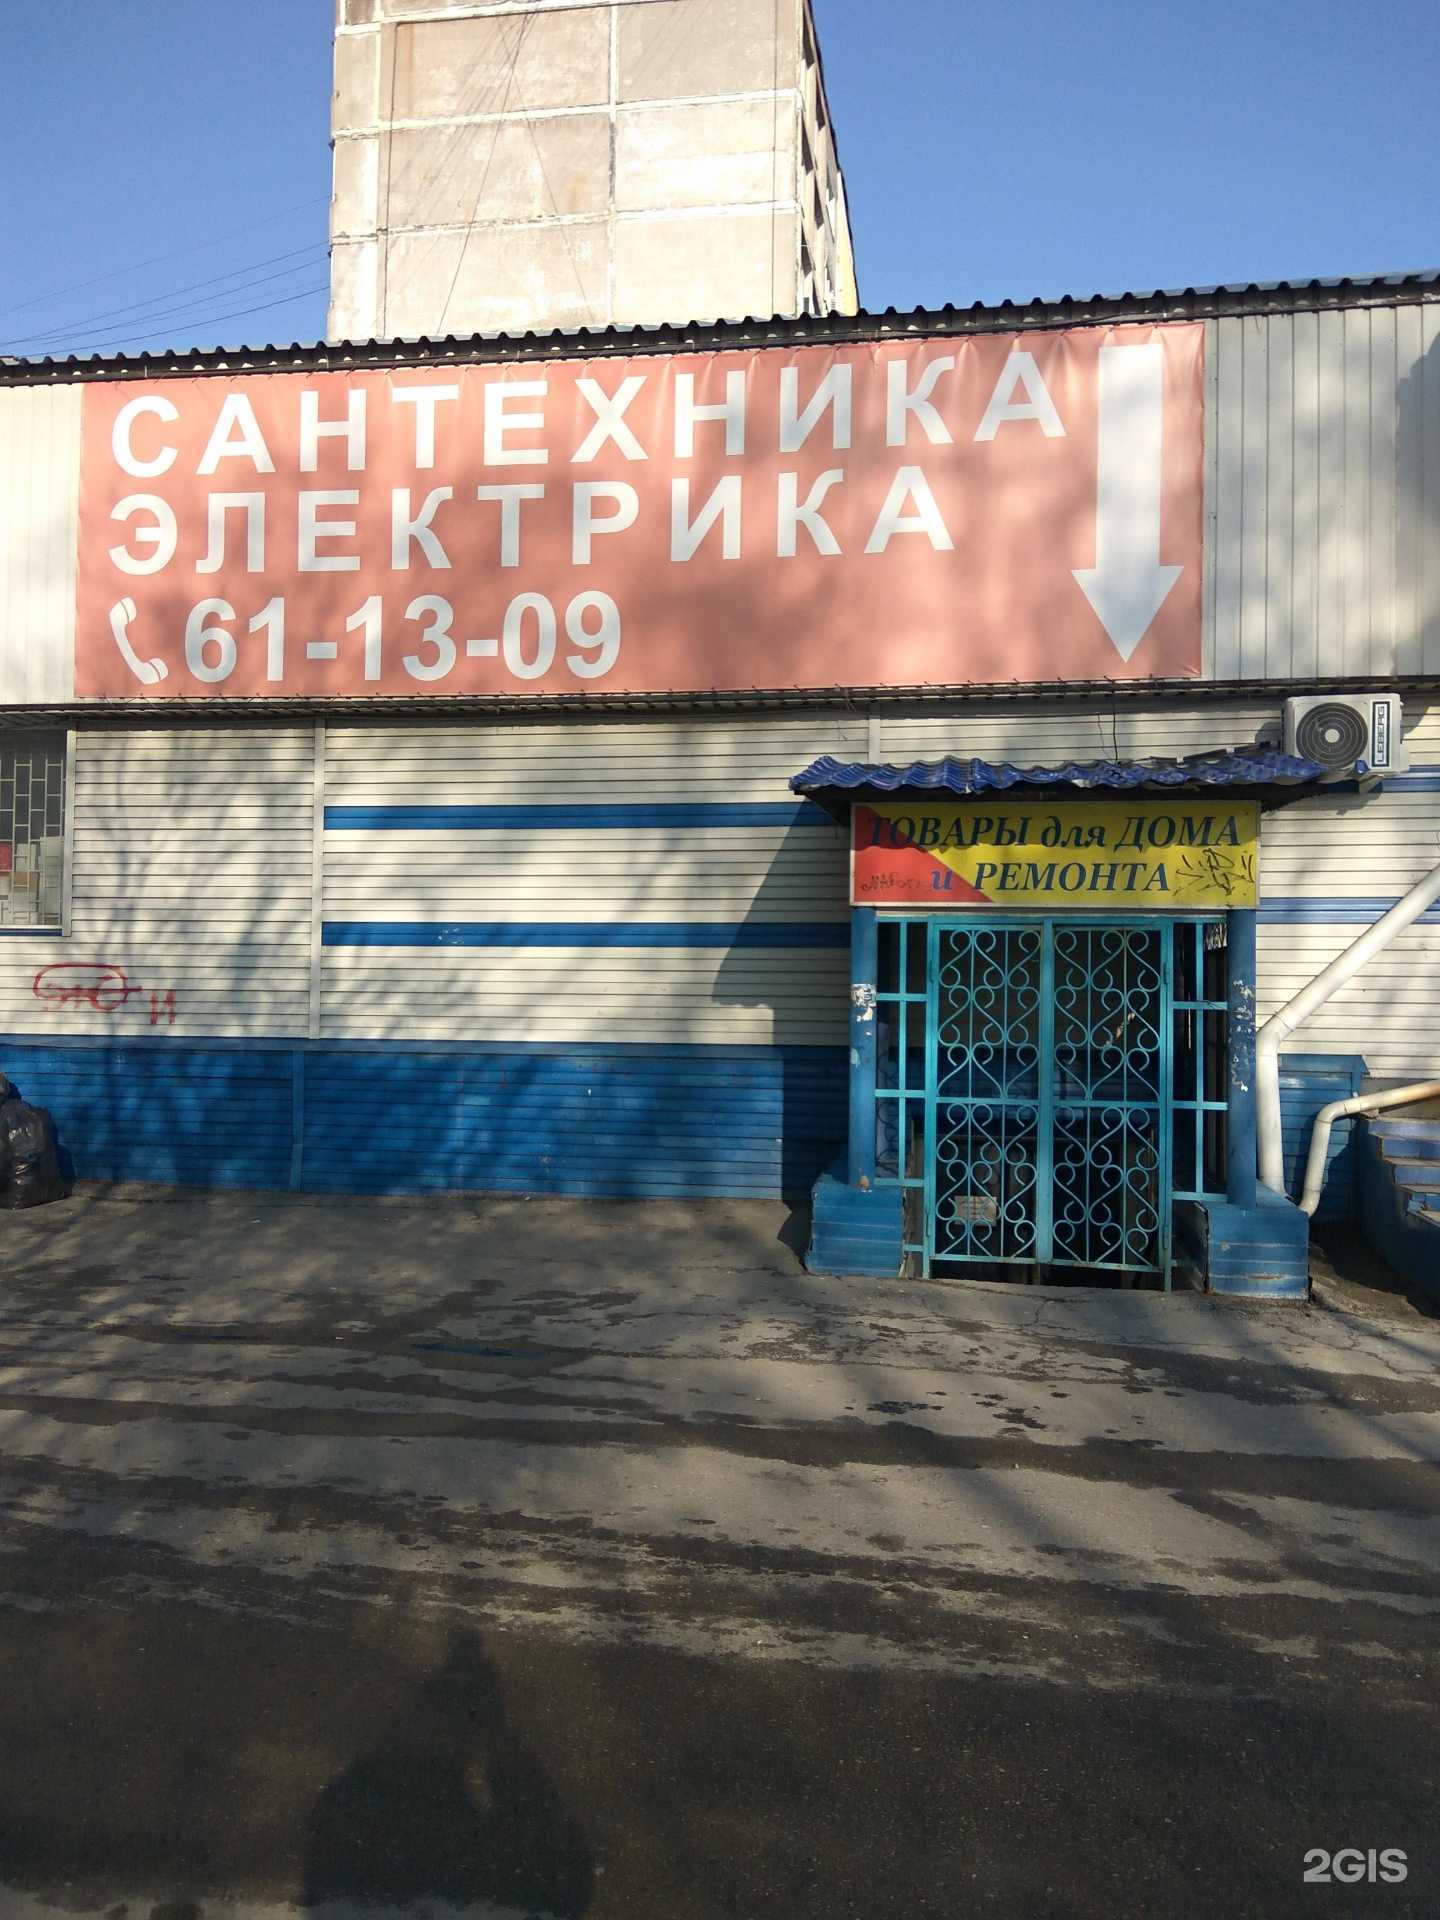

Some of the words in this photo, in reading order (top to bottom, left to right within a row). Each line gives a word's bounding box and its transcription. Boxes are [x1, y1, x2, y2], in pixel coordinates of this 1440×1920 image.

[111, 351, 1067, 478] САНТЕХНИКА
[108, 465, 955, 576] ЭЛЕКТРИКА
[184, 590, 622, 683] 61-13-09
[867, 815, 1031, 849] ТОВАРЫ
[1041, 815, 1106, 848] для
[1114, 815, 1241, 852] ДОМА
[930, 869, 953, 891] и
[973, 862, 1171, 892] РЕМОНТА
